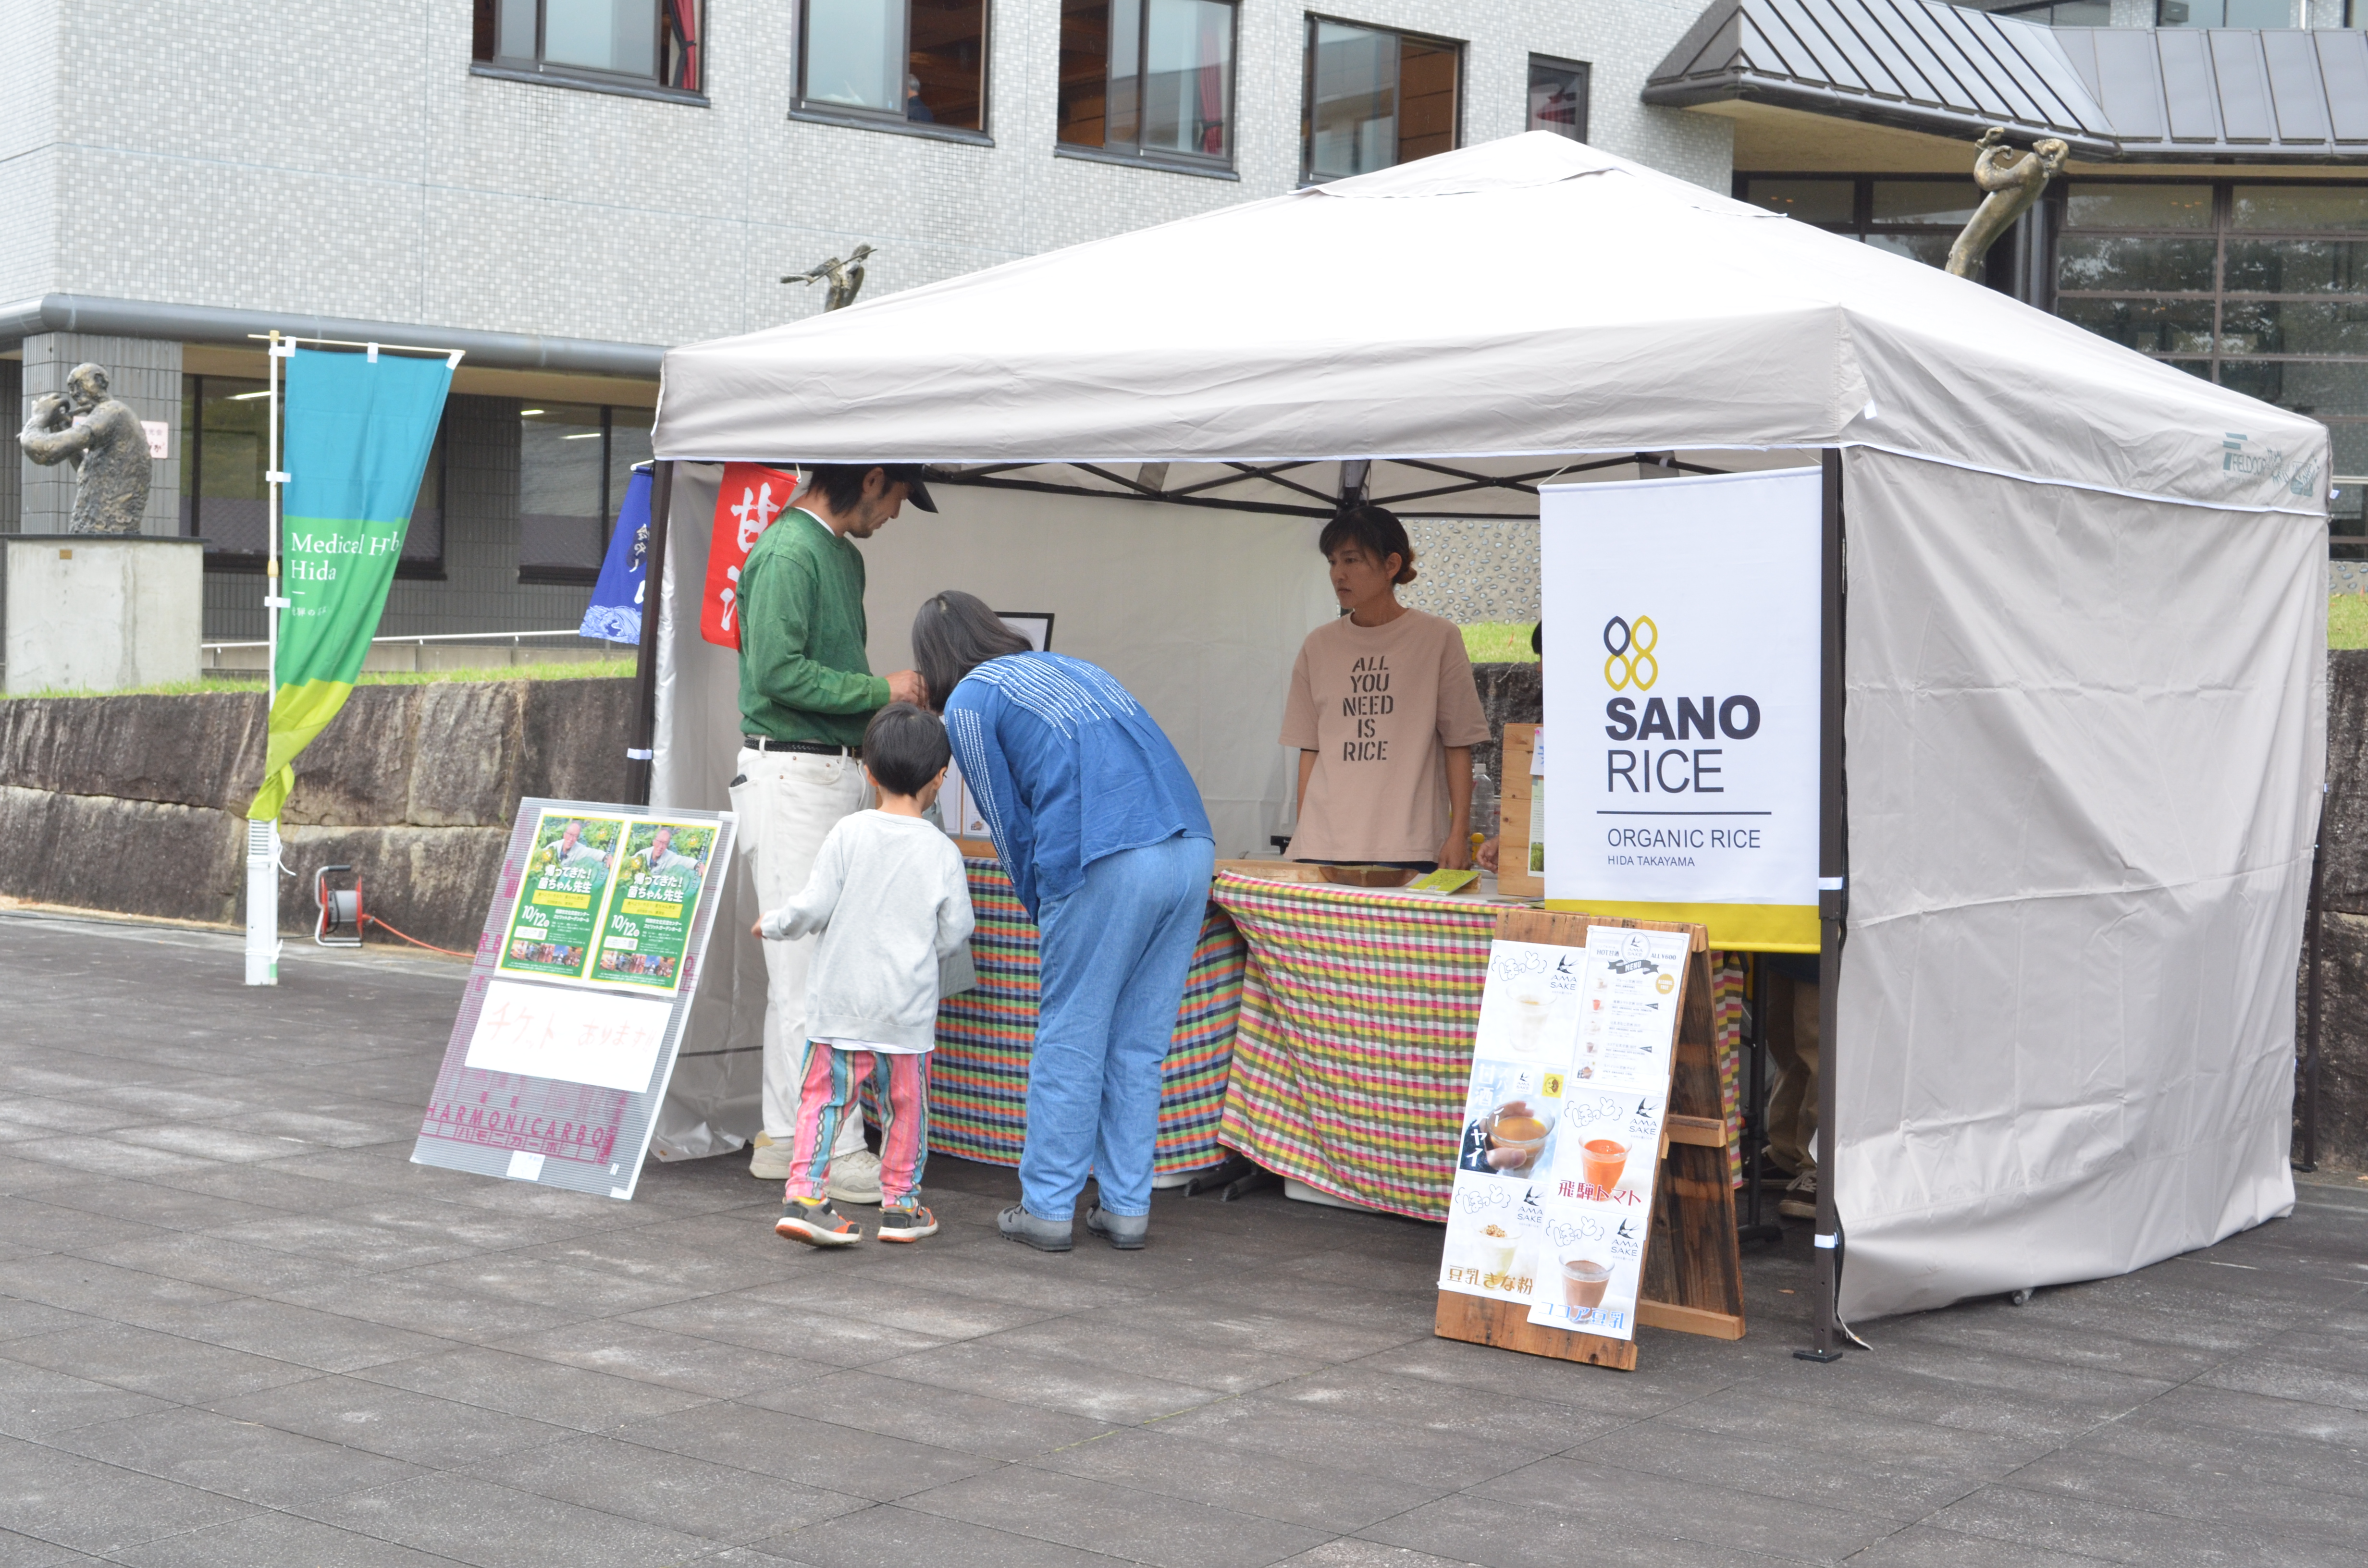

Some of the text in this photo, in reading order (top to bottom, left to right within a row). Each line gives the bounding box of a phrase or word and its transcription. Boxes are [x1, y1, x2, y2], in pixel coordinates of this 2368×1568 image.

[291, 532, 365, 554] Medical
[291, 560, 337, 580] Hida
[1352, 655, 1389, 673] ALL
[1350, 674, 1390, 693] YOU
[1343, 695, 1394, 716] NEED
[1605, 695, 1761, 741] SANO
[1357, 719, 1376, 738] IS
[1344, 741, 1389, 761] RICE
[1607, 749, 1725, 793] RICE
[1608, 828, 1761, 848] ORGANIC RICE
[1608, 856, 1695, 867] HIDA TAKAYAMA
[538, 877, 592, 894] 菌ちゃん先生
[627, 885, 684, 903] 菌ちゃん先生
[522, 905, 546, 927] 10/12
[611, 915, 636, 936] 10/12
[1625, 961, 1641, 972] MENU
[1550, 982, 1576, 990] SAKE
[486, 1001, 556, 1050] チケット
[1466, 1063, 1496, 1167] 甘酒チャイ
[1629, 1118, 1657, 1127] AMA
[1629, 1126, 1656, 1135] SAKE
[1558, 1179, 1641, 1206] 飛騨トマト
[1517, 1213, 1542, 1223] SAKE
[1518, 1206, 1543, 1215] AMA
[1611, 1239, 1639, 1249] AMA
[1611, 1246, 1638, 1256] SAKE
[1447, 1264, 1533, 1295] 豆乳きな粉
[1538, 1301, 1625, 1330] ココア豆乳
